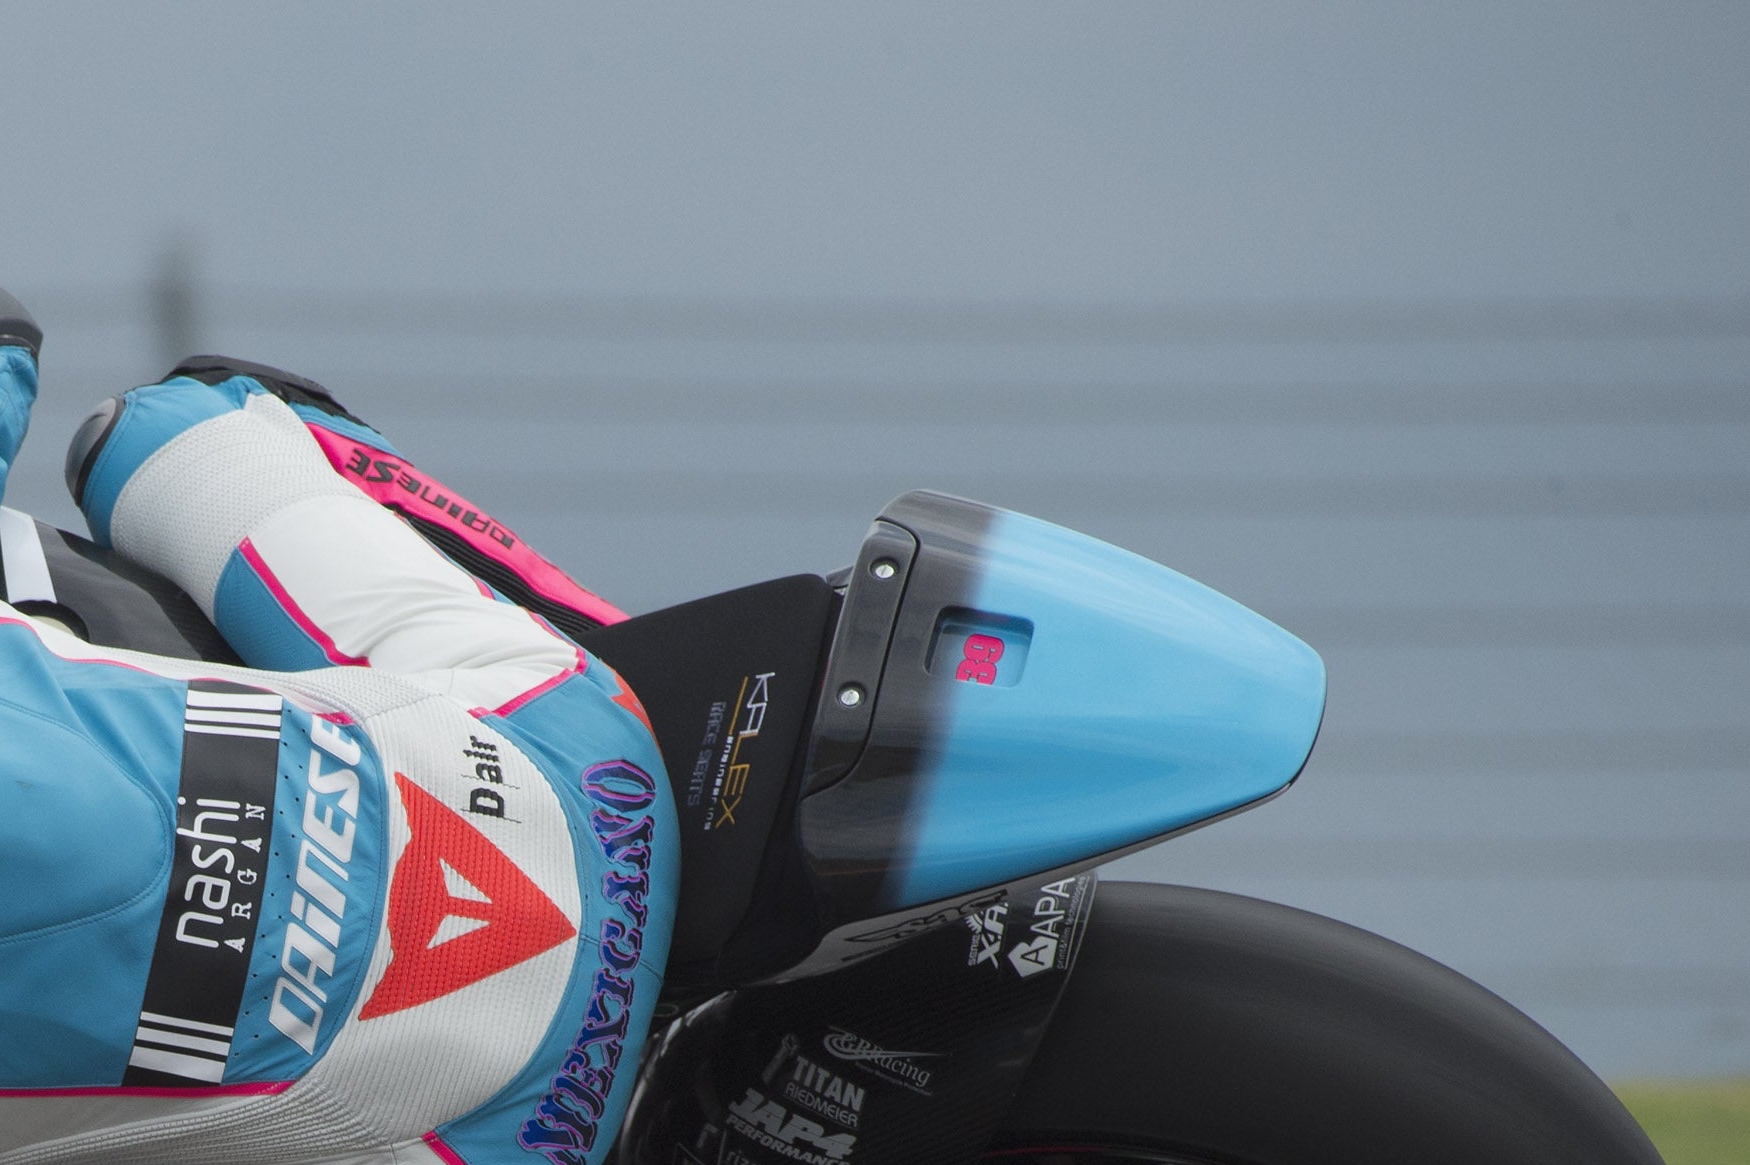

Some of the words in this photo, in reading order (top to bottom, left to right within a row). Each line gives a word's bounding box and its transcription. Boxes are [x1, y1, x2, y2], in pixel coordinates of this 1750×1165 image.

[956, 633, 1004, 684] 39
[176, 797, 241, 950] nashi
[224, 804, 267, 953] ARGAN
[792, 1054, 866, 1112] TITAN
